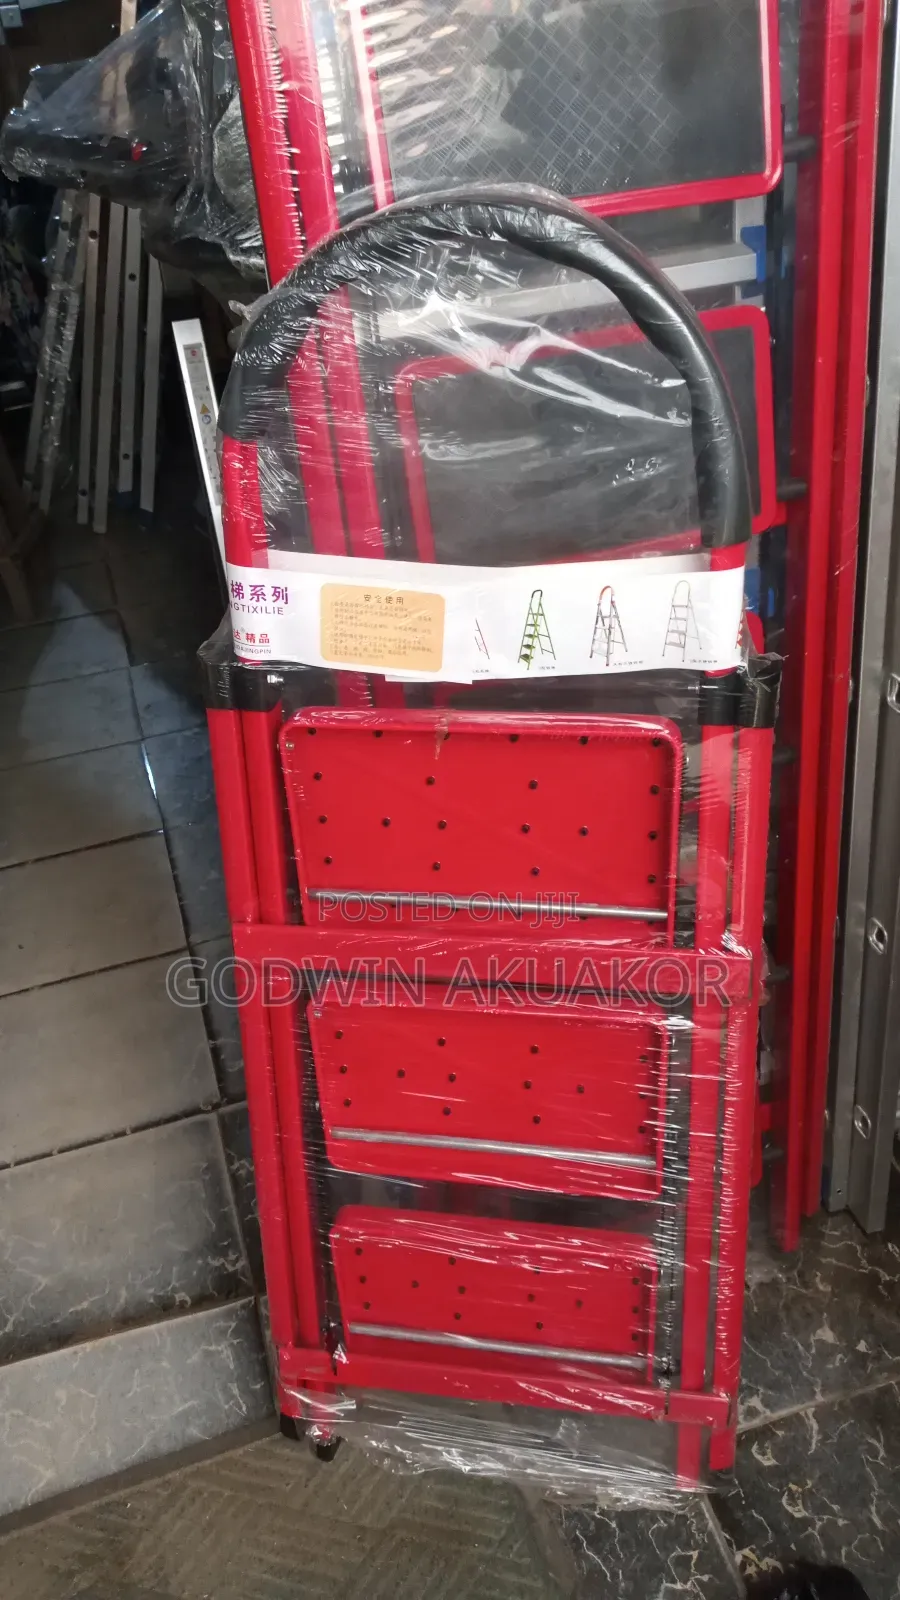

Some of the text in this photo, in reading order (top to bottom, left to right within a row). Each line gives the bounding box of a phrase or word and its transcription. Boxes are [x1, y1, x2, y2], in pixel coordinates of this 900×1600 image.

[231, 580, 288, 605] 梯系列
[364, 594, 404, 605] 安全使用
